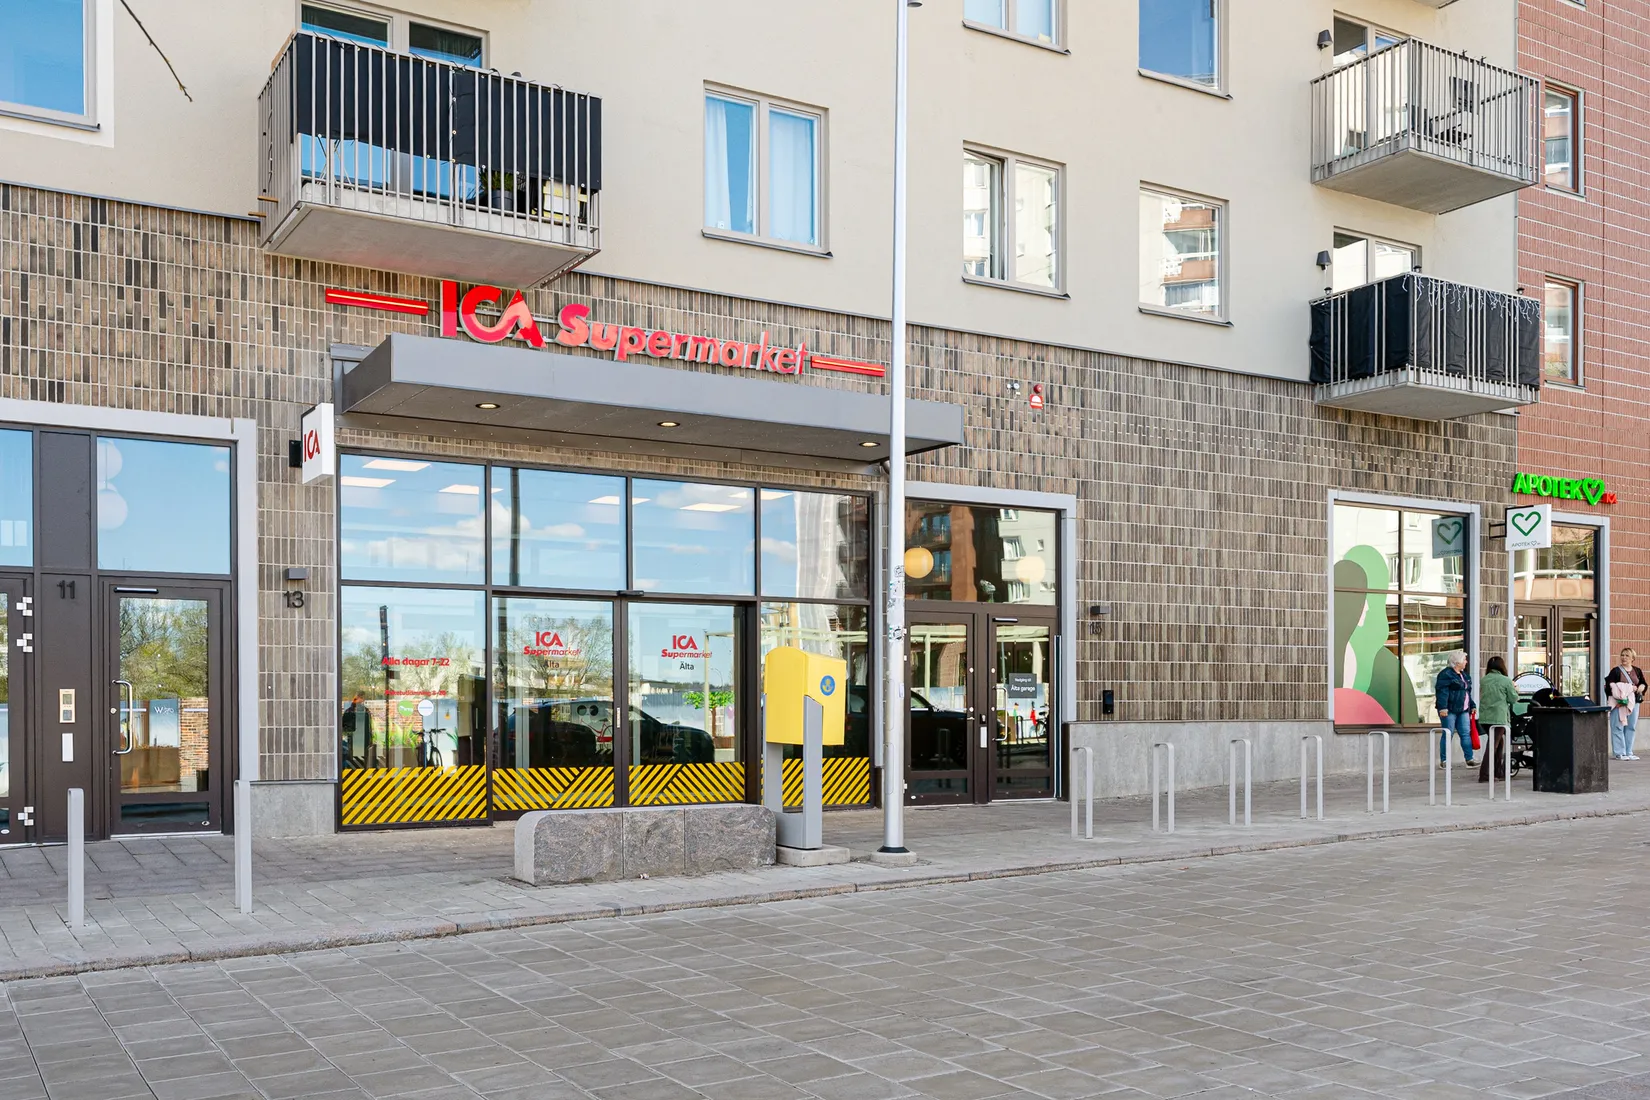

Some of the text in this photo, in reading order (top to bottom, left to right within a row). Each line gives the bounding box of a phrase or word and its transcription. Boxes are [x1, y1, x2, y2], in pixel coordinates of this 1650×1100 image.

[440, 280, 808, 375] ICA Supermarket
[304, 429, 320, 462] ICA
[1513, 472, 1583, 500] APOTEK
[57, 580, 76, 599] 11
[283, 590, 304, 608] 13
[535, 631, 564, 647] ICA
[672, 635, 698, 650] ICA
[523, 645, 581, 656] Supermarket
[661, 648, 712, 659] Supermarket
[382, 656, 450, 668] Alla dagar 7-22
[679, 660, 695, 671] Älta
